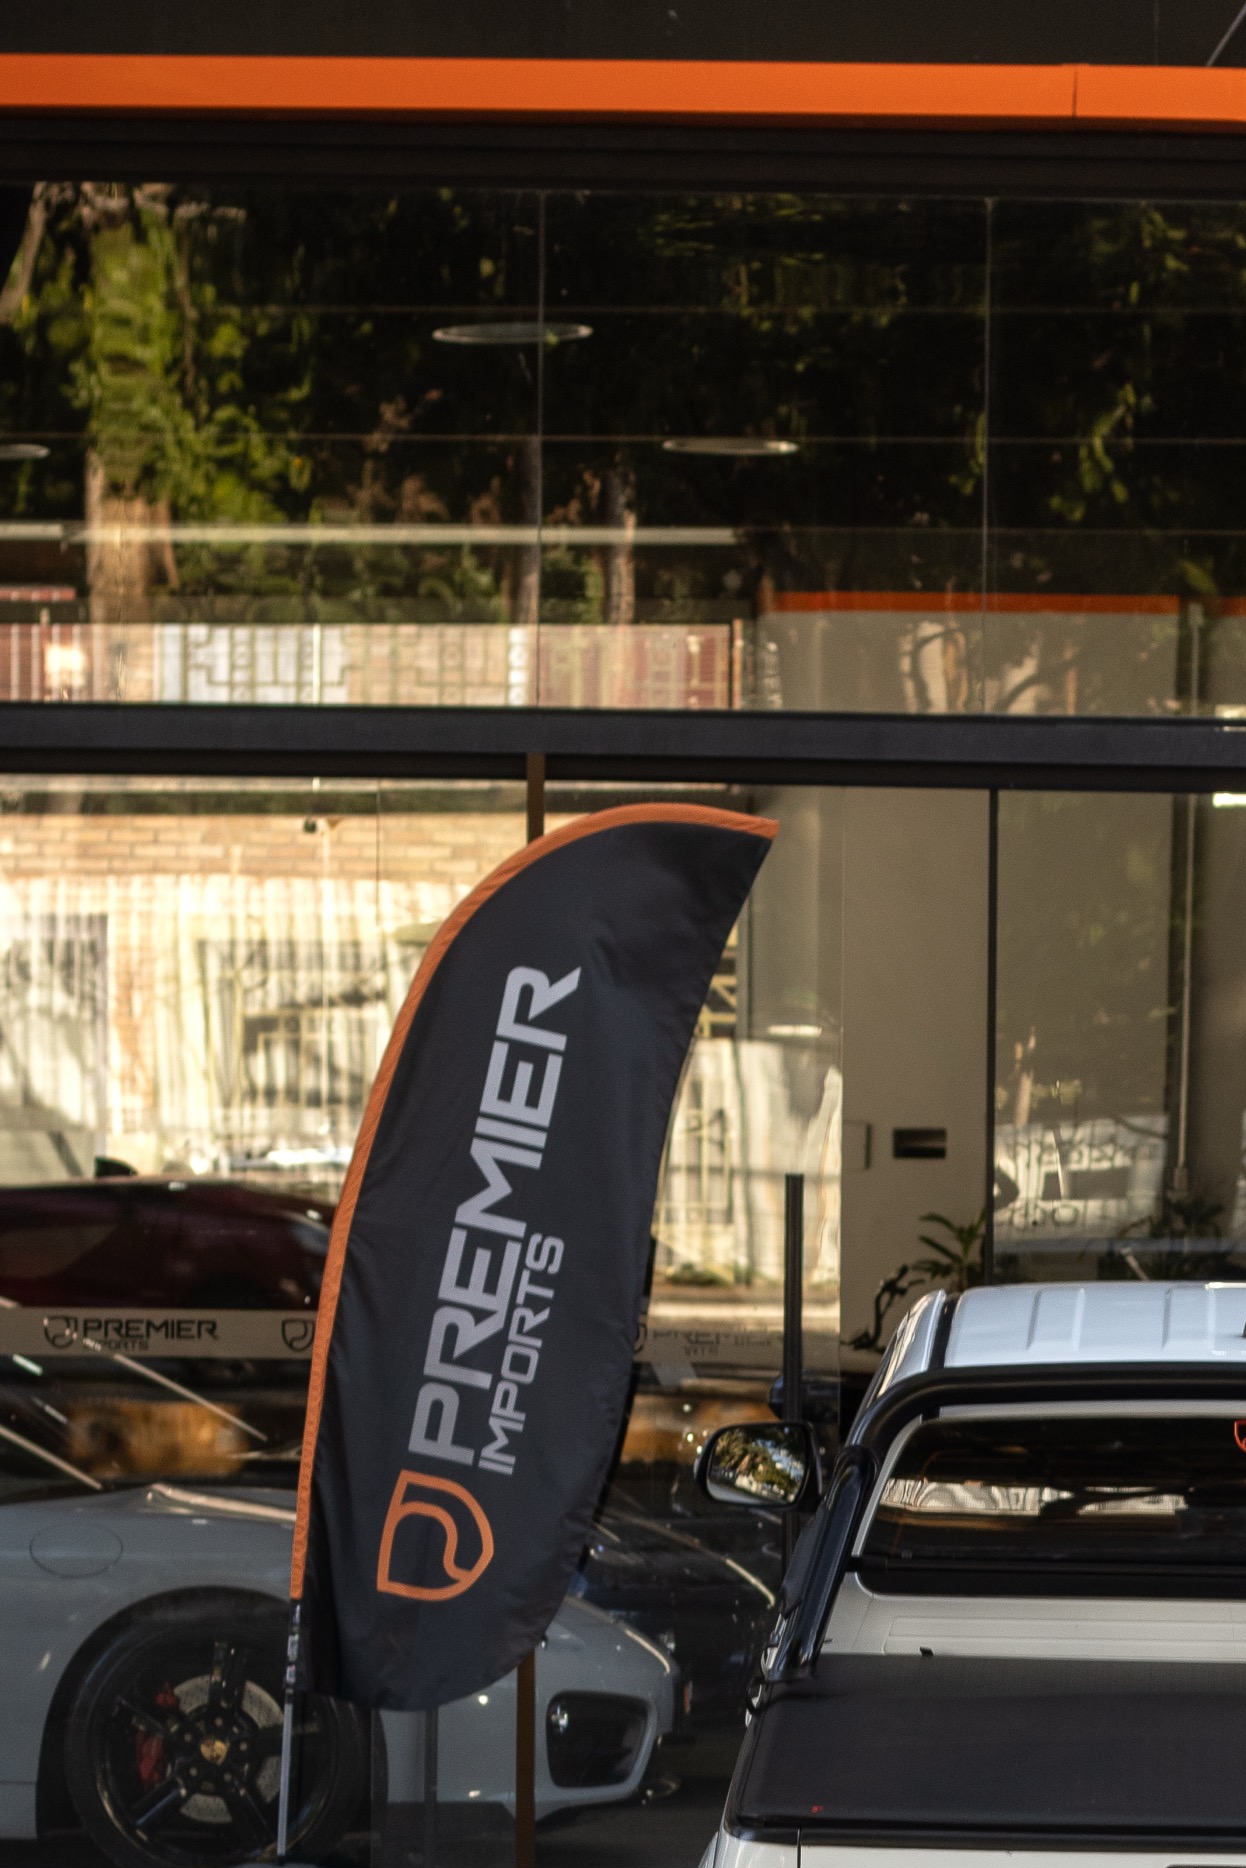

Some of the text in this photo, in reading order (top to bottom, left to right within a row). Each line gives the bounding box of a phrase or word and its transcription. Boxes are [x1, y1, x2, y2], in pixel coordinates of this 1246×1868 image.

[83, 1318, 219, 1341] PREMIER
[408, 966, 582, 1466] PREMIER
[478, 1233, 565, 1475] IMPORTS
